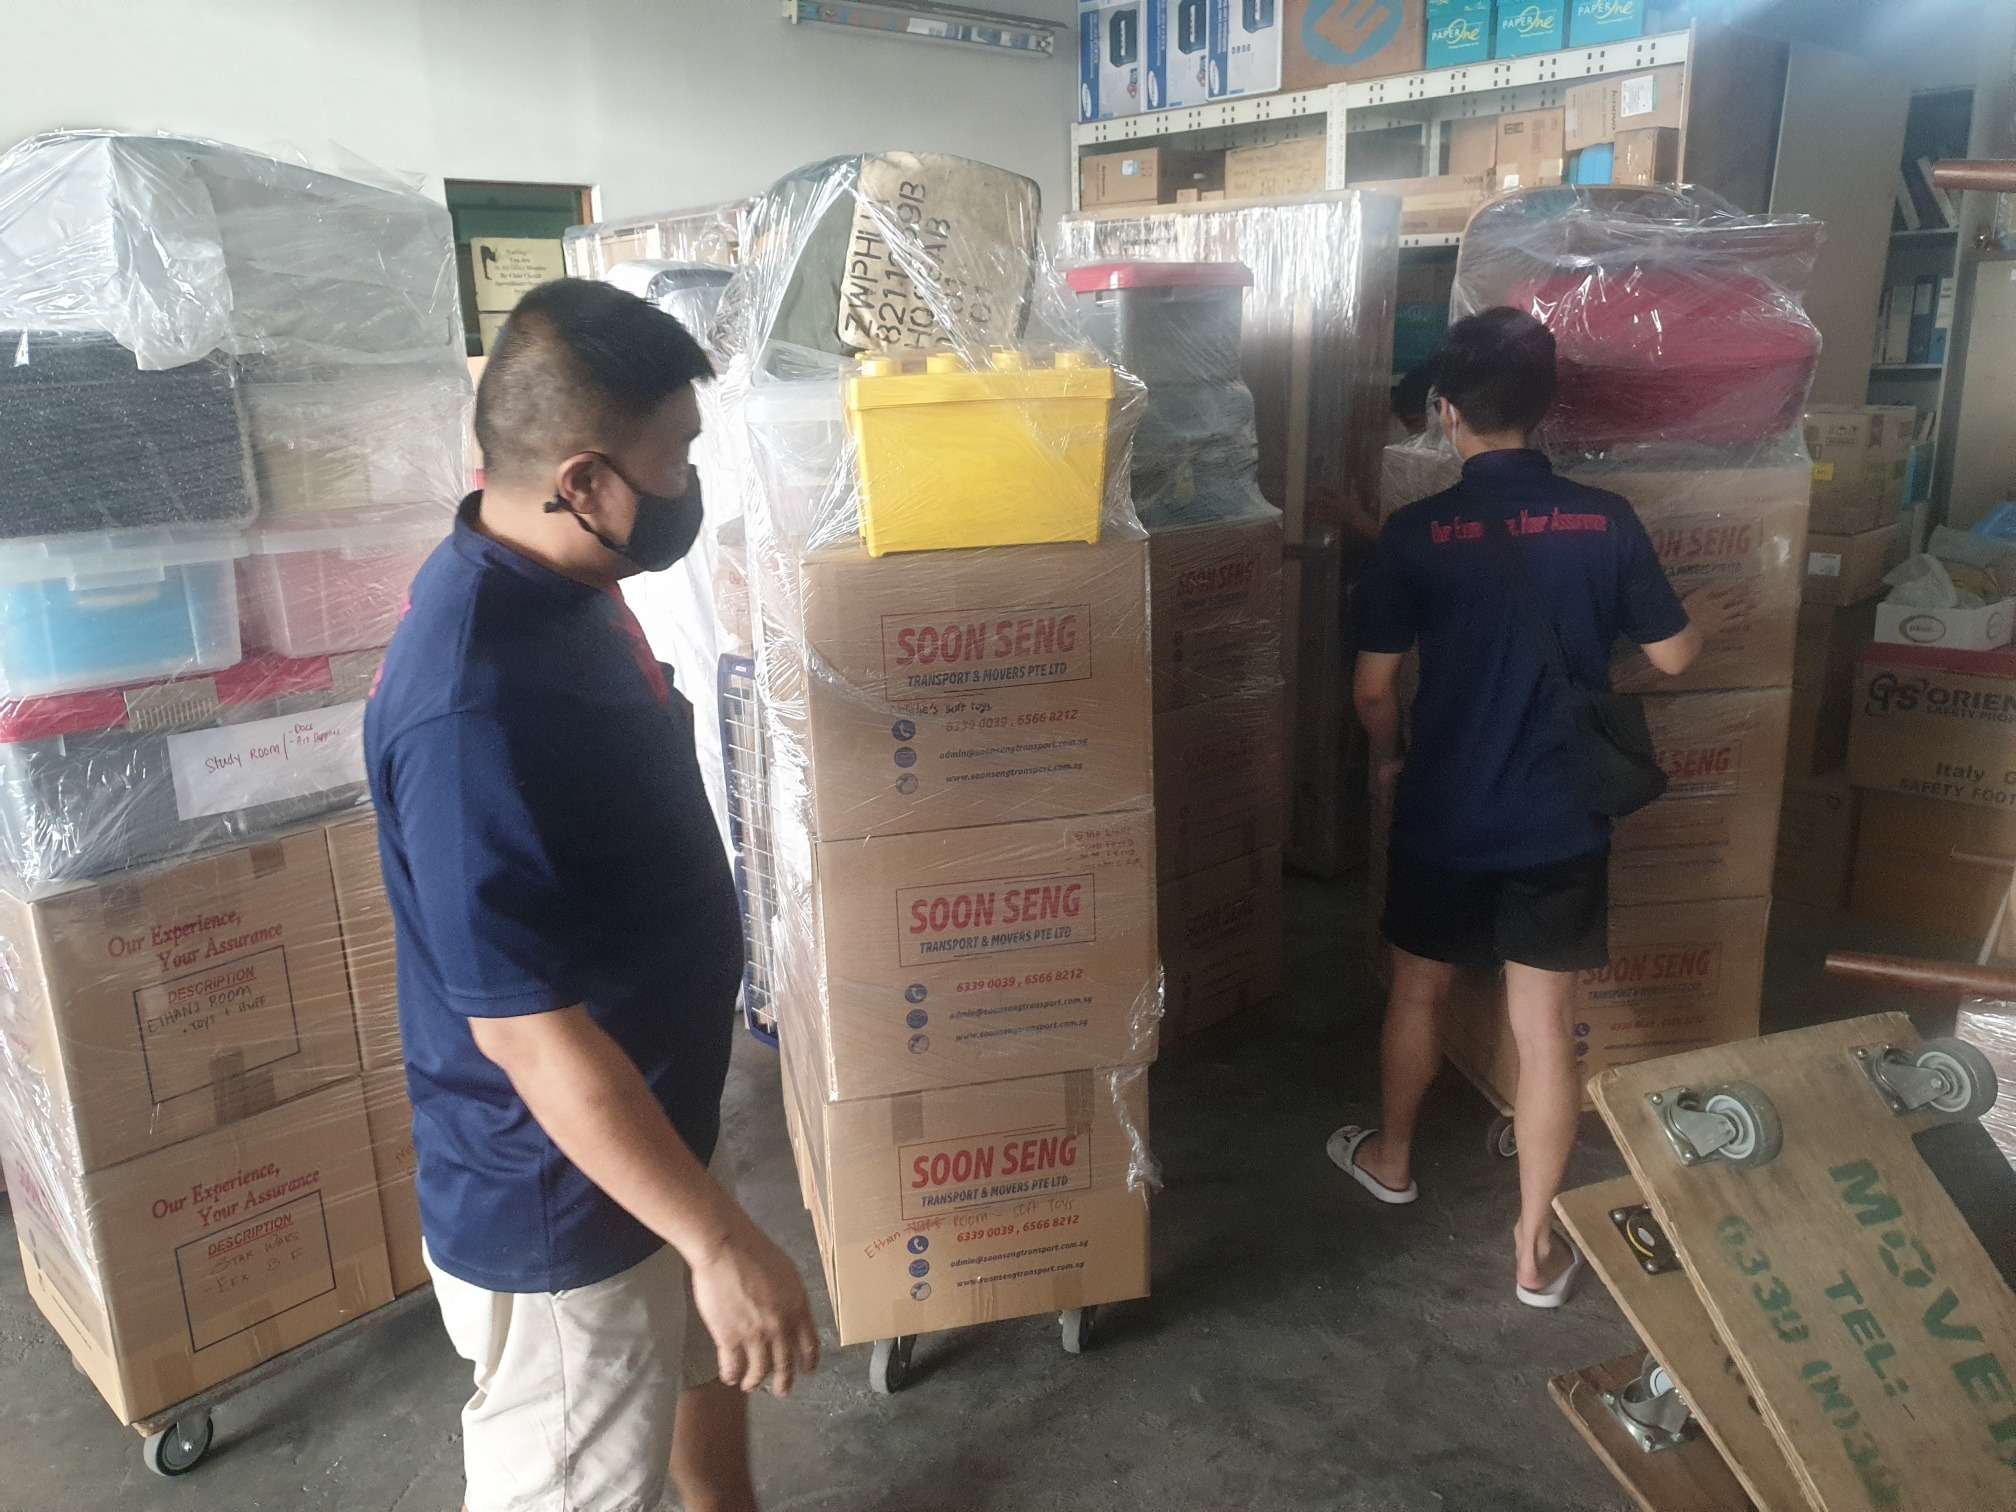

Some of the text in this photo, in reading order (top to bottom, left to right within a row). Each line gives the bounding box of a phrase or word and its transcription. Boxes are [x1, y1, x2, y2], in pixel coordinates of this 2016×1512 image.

[895, 614, 1077, 666] SOON SENG
[907, 670, 970, 688] TRANSPORT
[982, 664, 1026, 681] MOVERS
[1028, 663, 1048, 677] PTE
[1048, 662, 1068, 676] LTD
[204, 752, 242, 775] Study
[1935, 762, 1985, 783] Italy
[1901, 778, 1965, 798] SAFETY
[909, 883, 1082, 935] SOON SENG
[108, 909, 242, 958] Our Experience,
[157, 923, 283, 973] Your Assurance
[919, 926, 1072, 955] TRANSPORT & MOVERS PTE LTD
[168, 966, 257, 1004] DESCRIPTION
[956, 979, 985, 993] 6339
[1024, 972, 1053, 985] 6566
[1055, 968, 1083, 981] 8212
[911, 1134, 1078, 1189] SOON SENG
[152, 1162, 281, 1219] Our Experience,
[197, 1170, 320, 1228] Your Assurance
[921, 1176, 1069, 1208] TRANSPORT & MOVERS PTE LTD
[207, 1213, 294, 1258] DESCRIPTION
[956, 1229, 985, 1243] 6339
[1022, 1218, 1050, 1232] 6566
[1052, 1214, 1080, 1227] 8212
